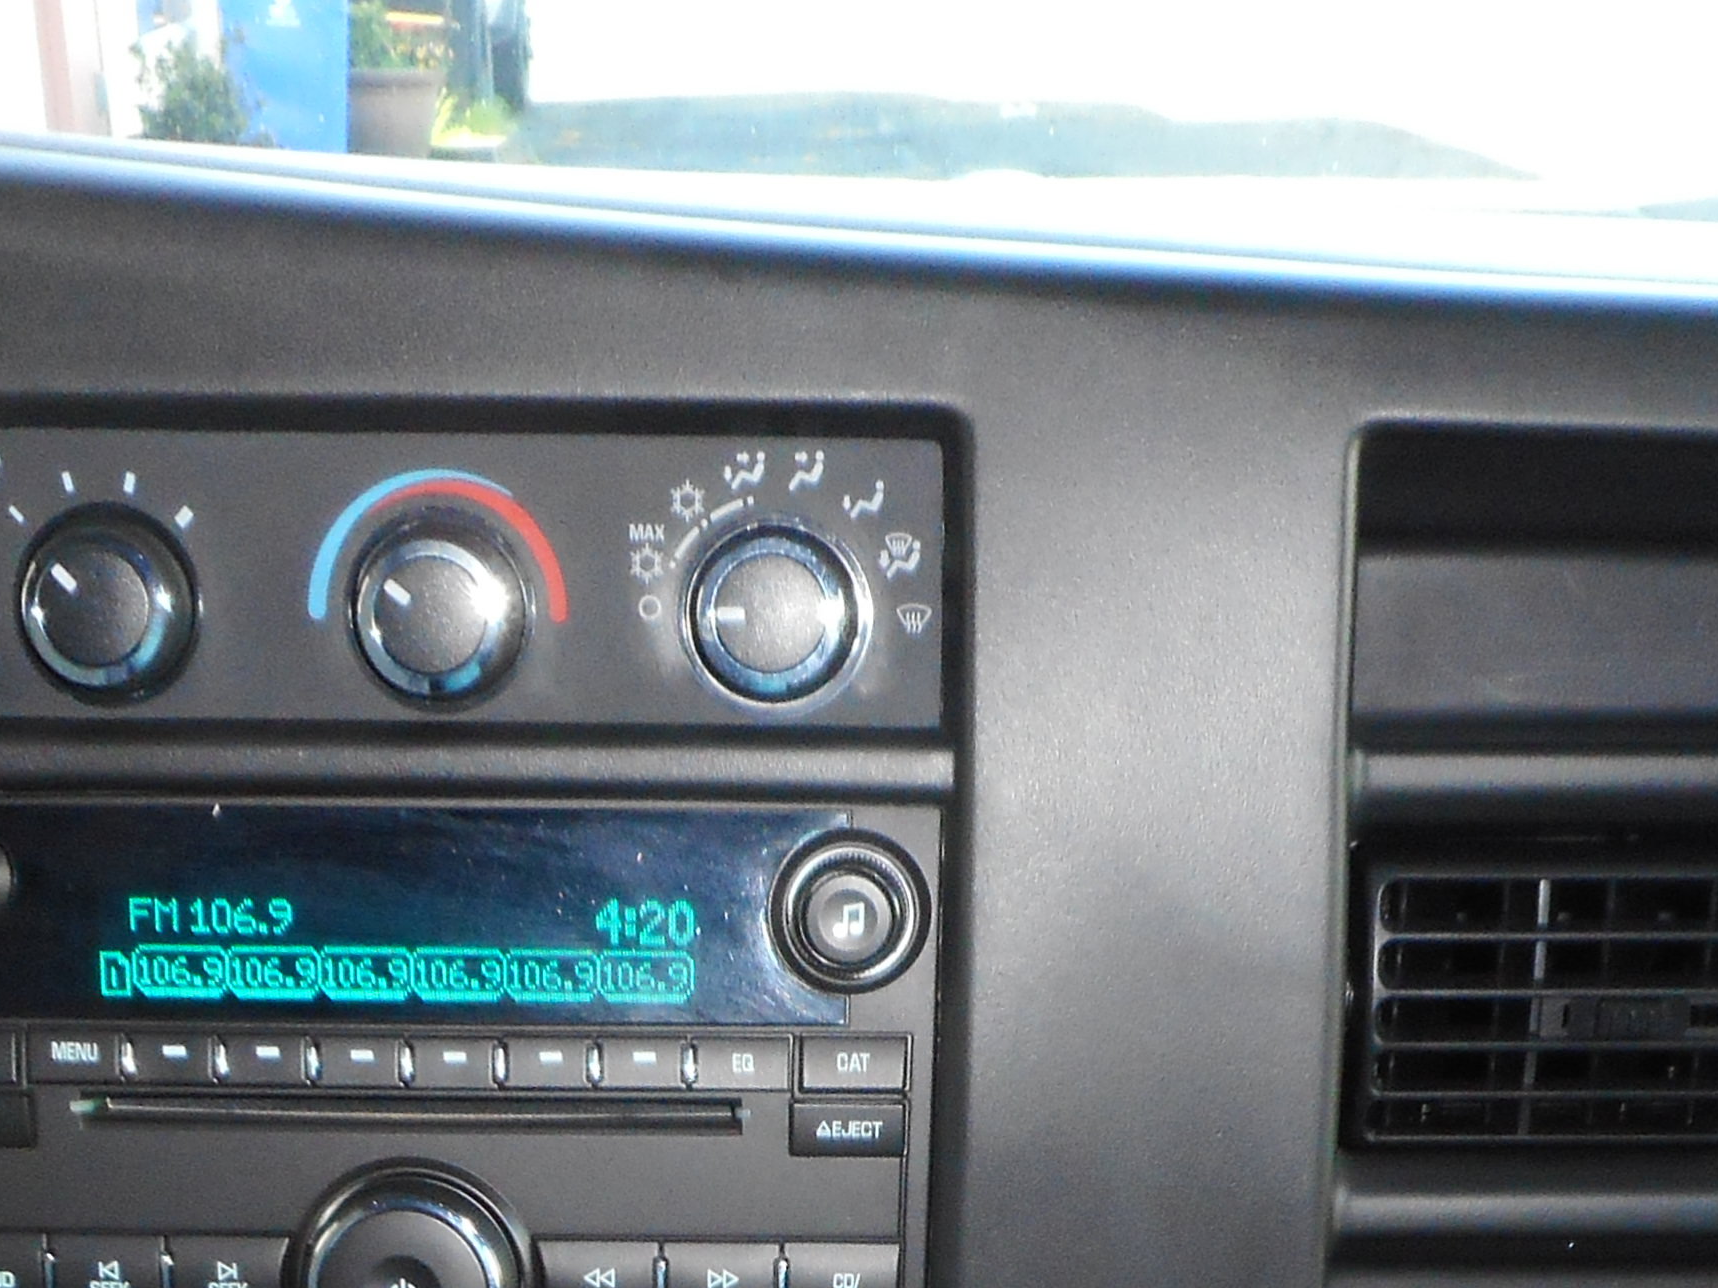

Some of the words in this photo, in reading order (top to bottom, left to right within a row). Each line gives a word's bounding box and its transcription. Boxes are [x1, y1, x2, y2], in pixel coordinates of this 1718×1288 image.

[629, 523, 665, 542] MAX
[128, 896, 180, 933] FM
[189, 898, 294, 936] 106.9
[592, 897, 695, 948] 4:20
[139, 953, 223, 986] 106.9
[230, 953, 316, 986] 106.9
[323, 954, 410, 987] 106.9
[414, 954, 502, 987] 106.9
[508, 955, 595, 988] 106.9
[603, 956, 691, 989] 106.9
[51, 1041, 99, 1063] MENU
[731, 1052, 755, 1073] EQ
[836, 1052, 871, 1073] CAT
[831, 1119, 884, 1140] EJECT
